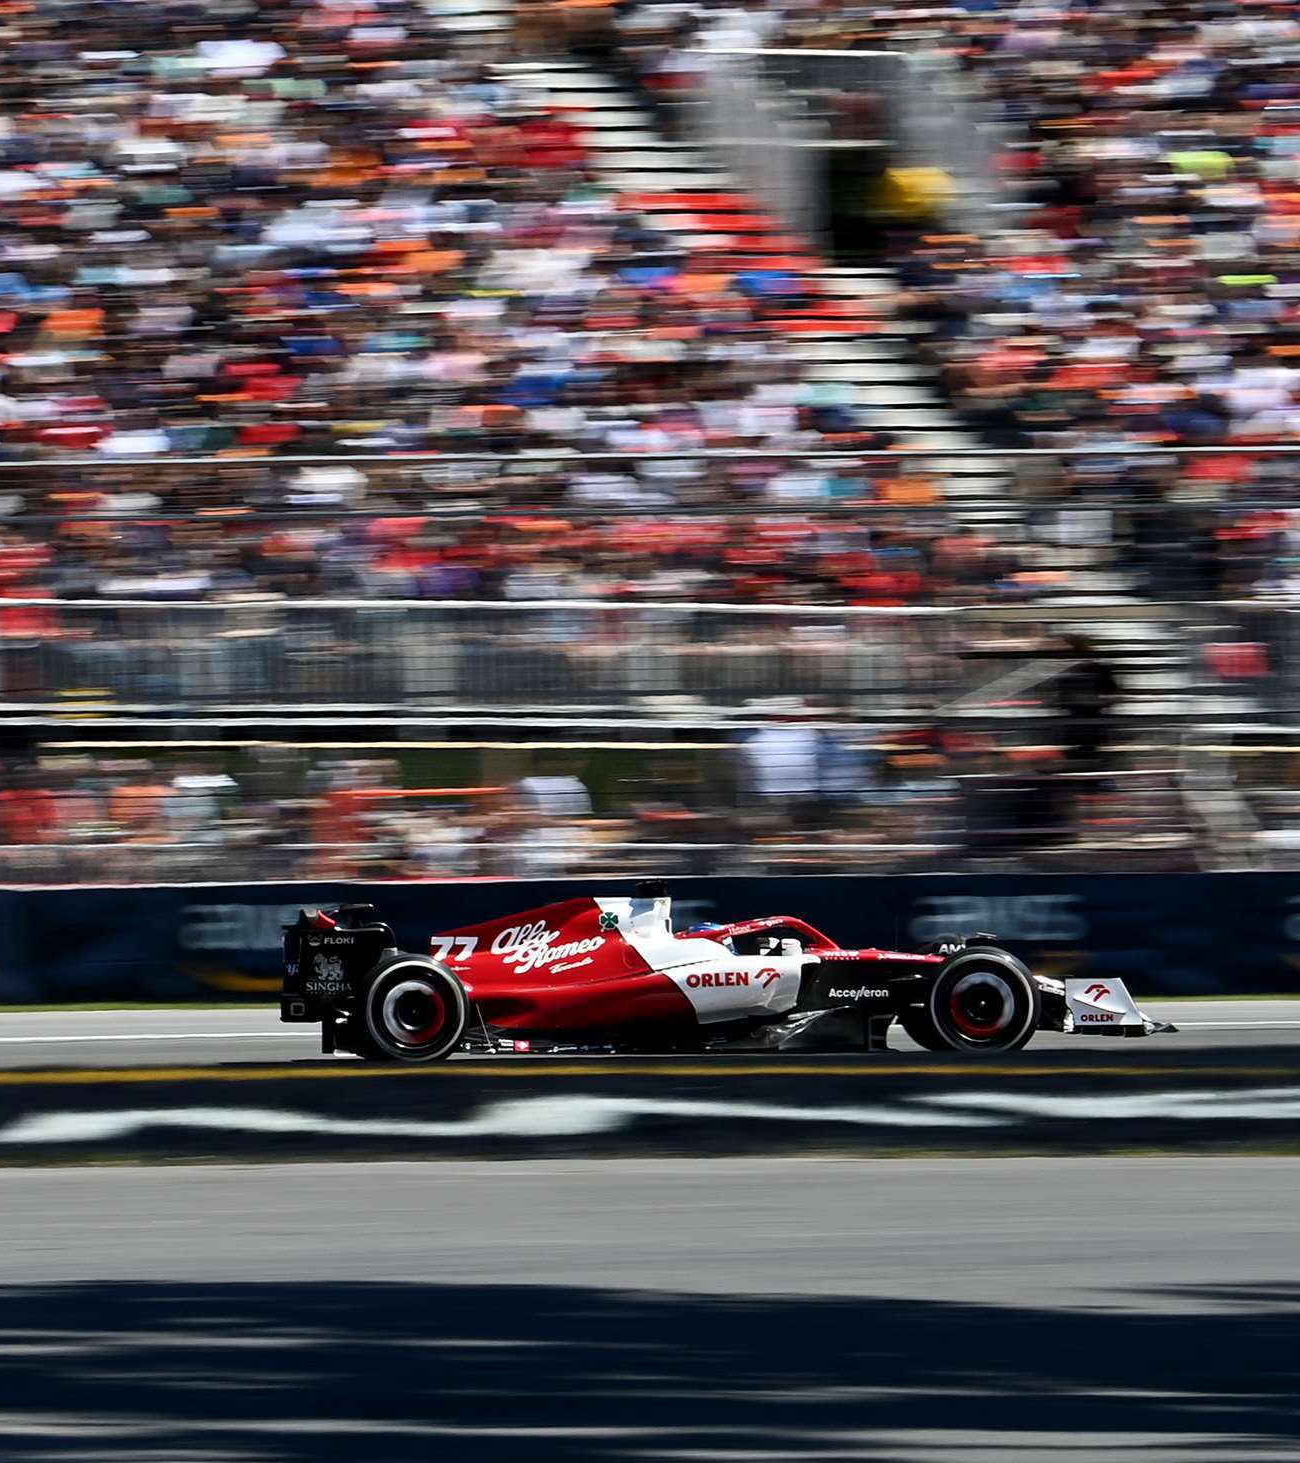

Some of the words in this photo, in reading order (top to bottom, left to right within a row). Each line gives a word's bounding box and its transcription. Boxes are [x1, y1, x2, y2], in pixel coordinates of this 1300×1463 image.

[323, 936, 355, 945] FLOKI
[491, 919, 560, 954] Alfa
[430, 936, 479, 961] 77
[503, 936, 606, 974] Romeo
[305, 981, 353, 992] SINGHA
[686, 971, 749, 988] ORLEN
[1080, 1013, 1114, 1023] ORLEN
